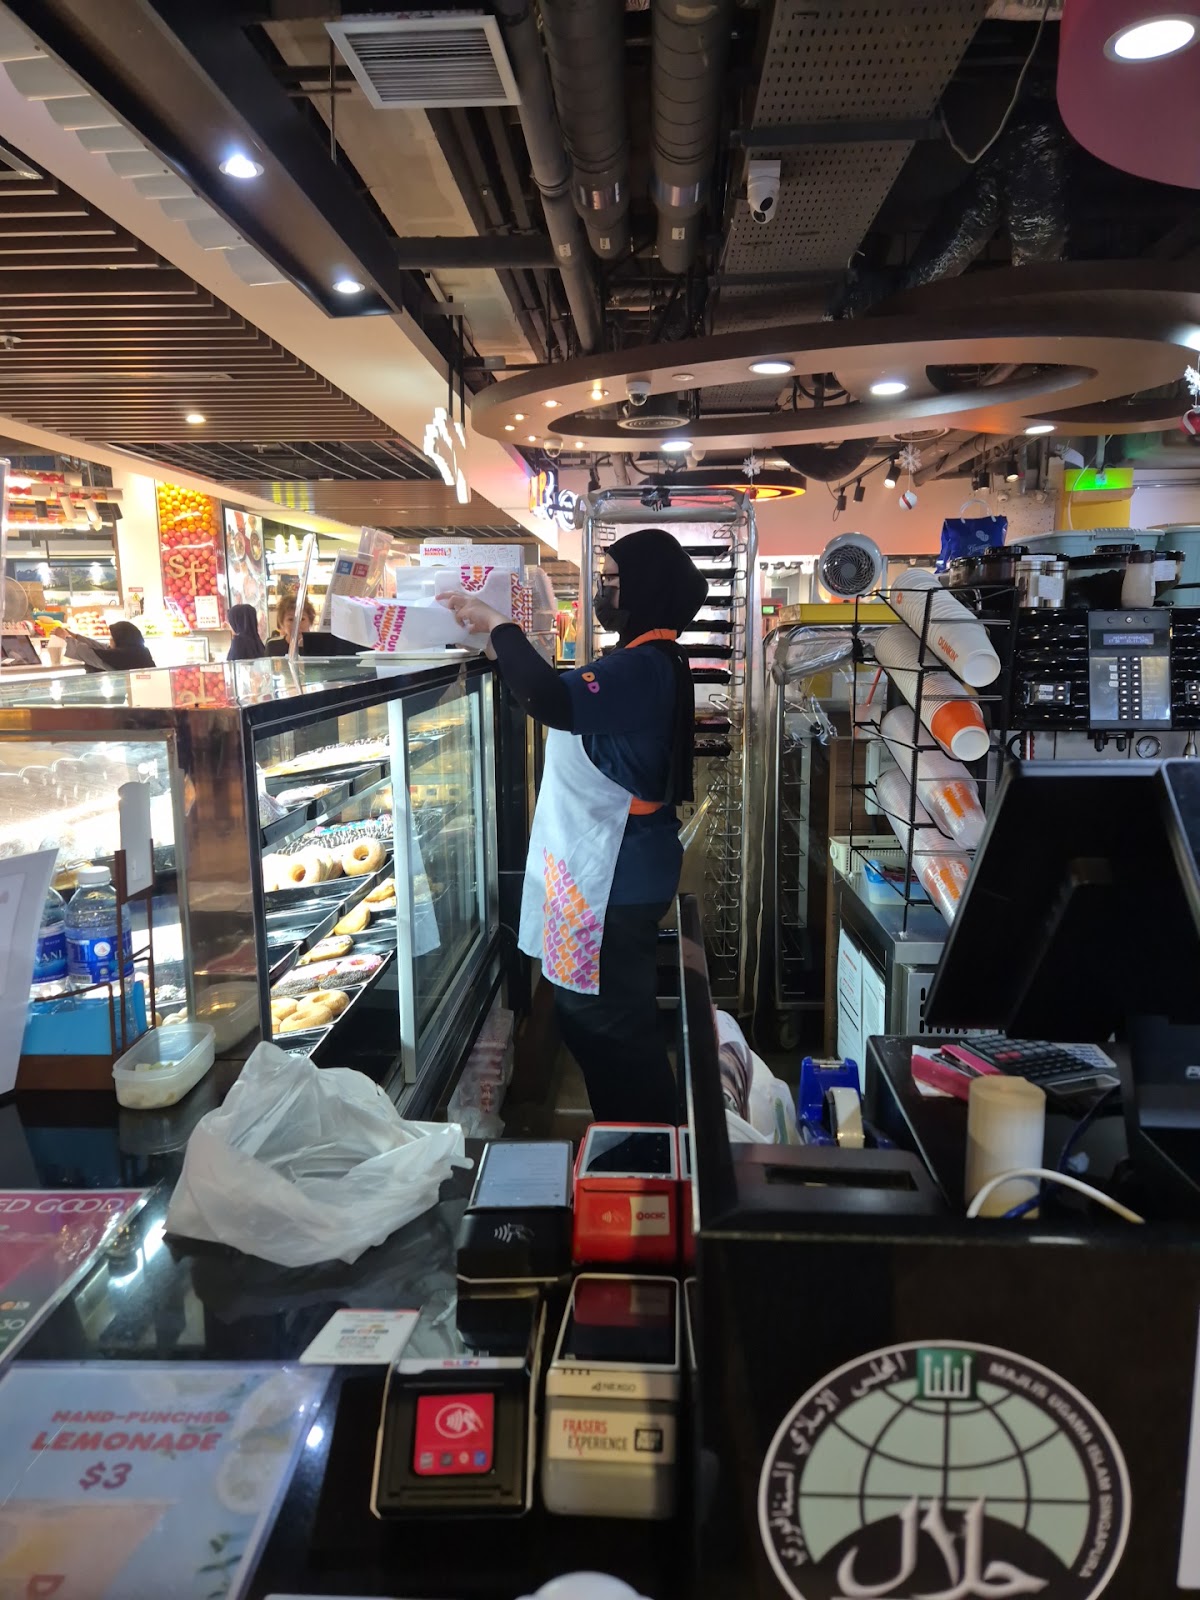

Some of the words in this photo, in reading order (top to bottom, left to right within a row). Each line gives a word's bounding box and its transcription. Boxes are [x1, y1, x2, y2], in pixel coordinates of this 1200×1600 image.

[34, 1198, 124, 1214] GOOD
[988, 1361, 1048, 1401] MAJLIS
[563, 1418, 608, 1435] FRASERS
[31, 1431, 222, 1452] LEMONADE
[568, 1435, 628, 1452] EXPERIENCE
[78, 1459, 133, 1491] $3
[1088, 1442, 1111, 1492] ISLAM
[1079, 1494, 1113, 1579] SINGAPURA
